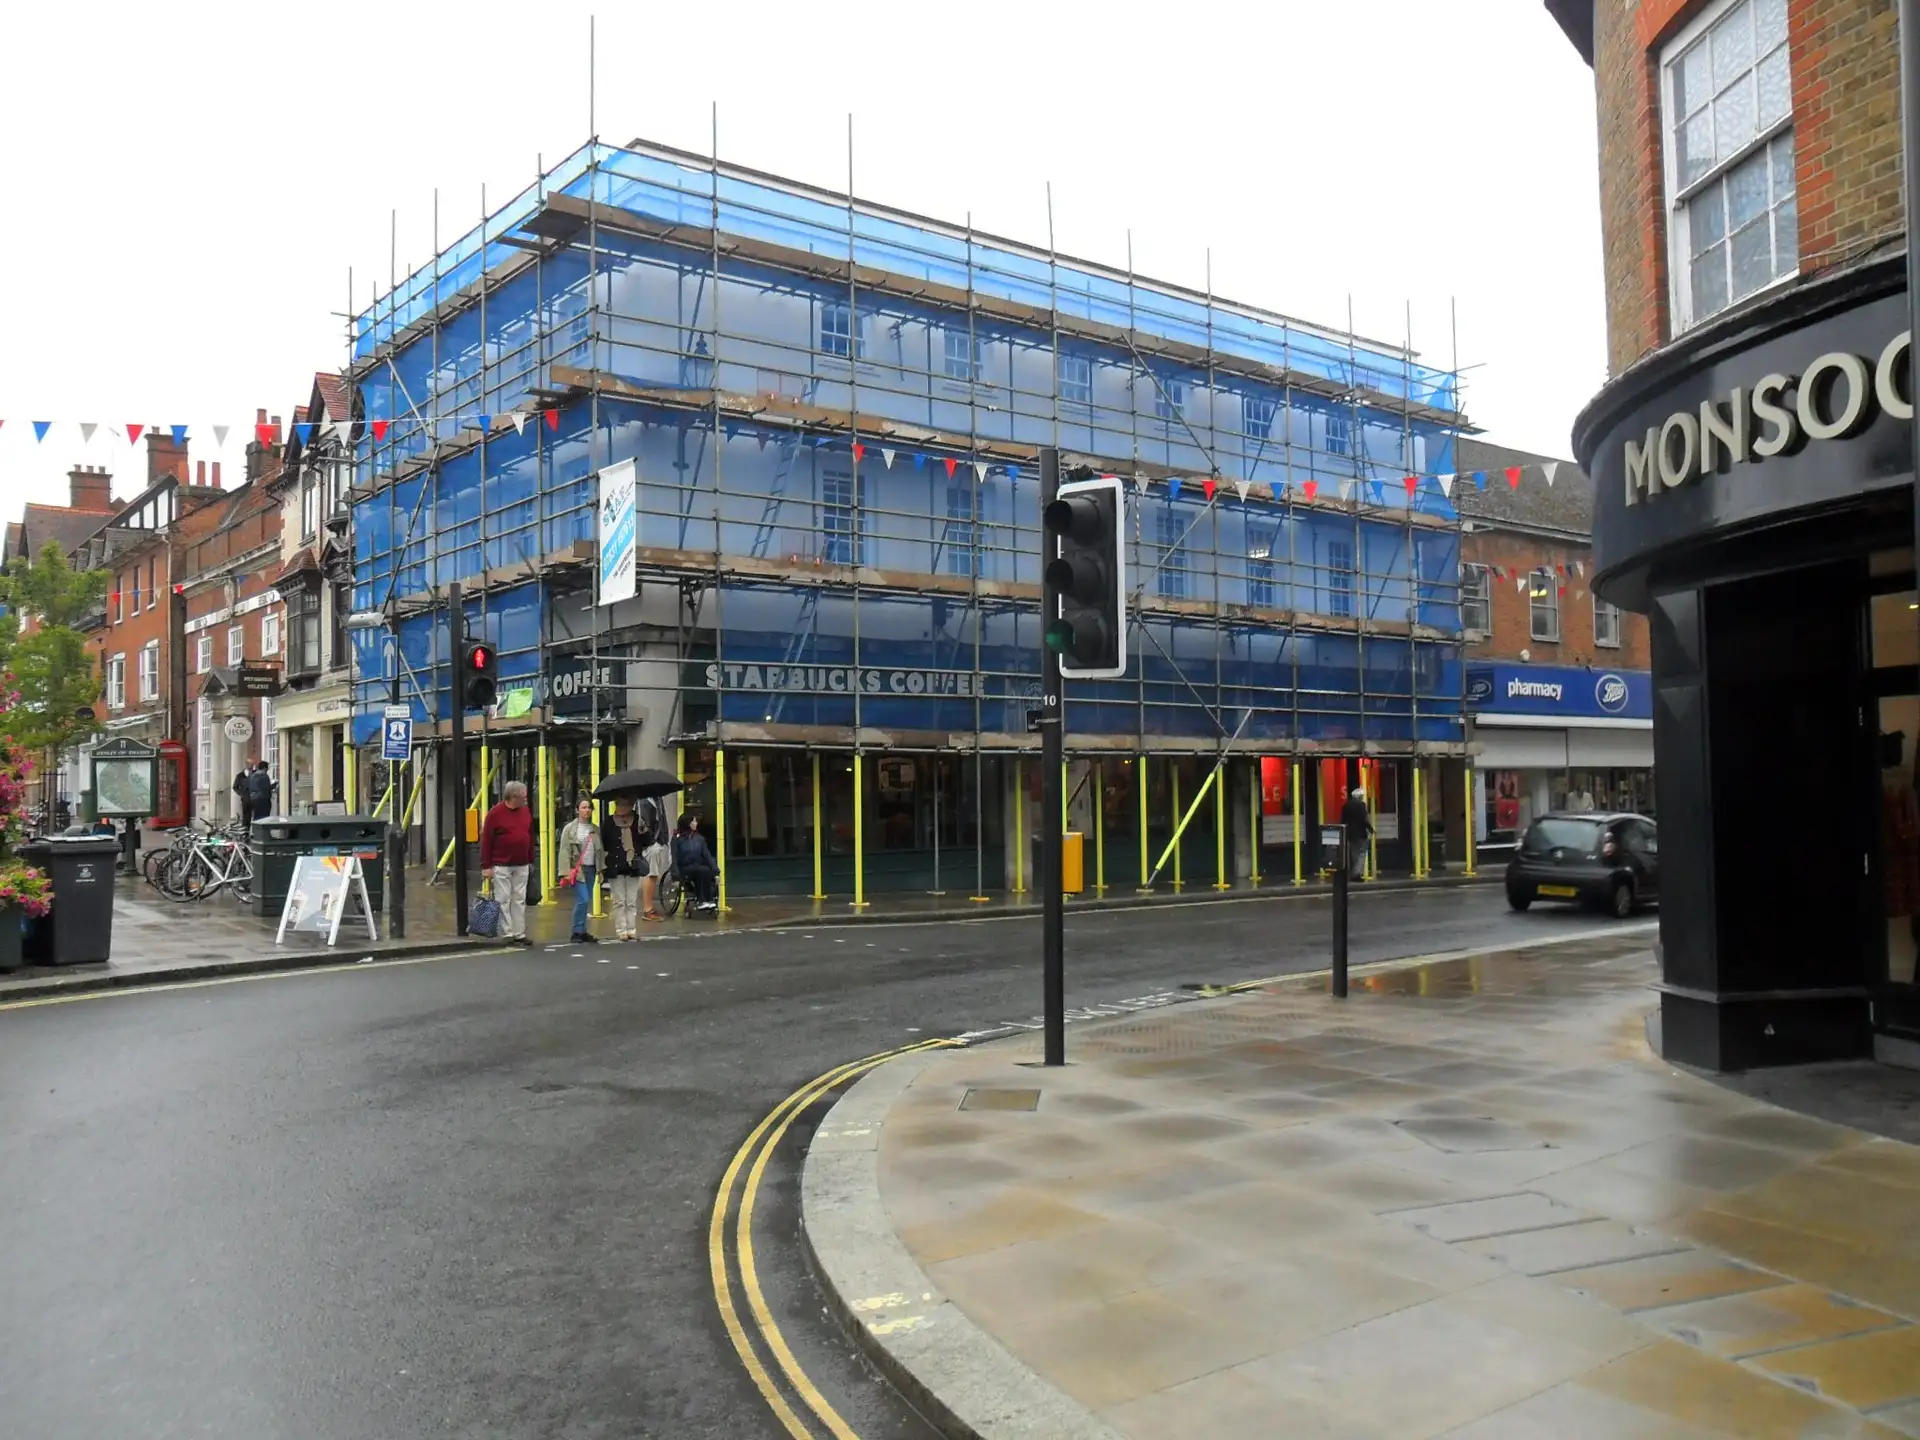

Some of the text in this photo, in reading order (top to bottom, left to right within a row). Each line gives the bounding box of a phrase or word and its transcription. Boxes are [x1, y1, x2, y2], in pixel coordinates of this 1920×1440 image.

[705, 664, 986, 700] STARBUCKS COFFEE
[1507, 677, 1563, 701] pharmacy
[1042, 695, 1057, 706] 10
[228, 728, 250, 736] HSBC
